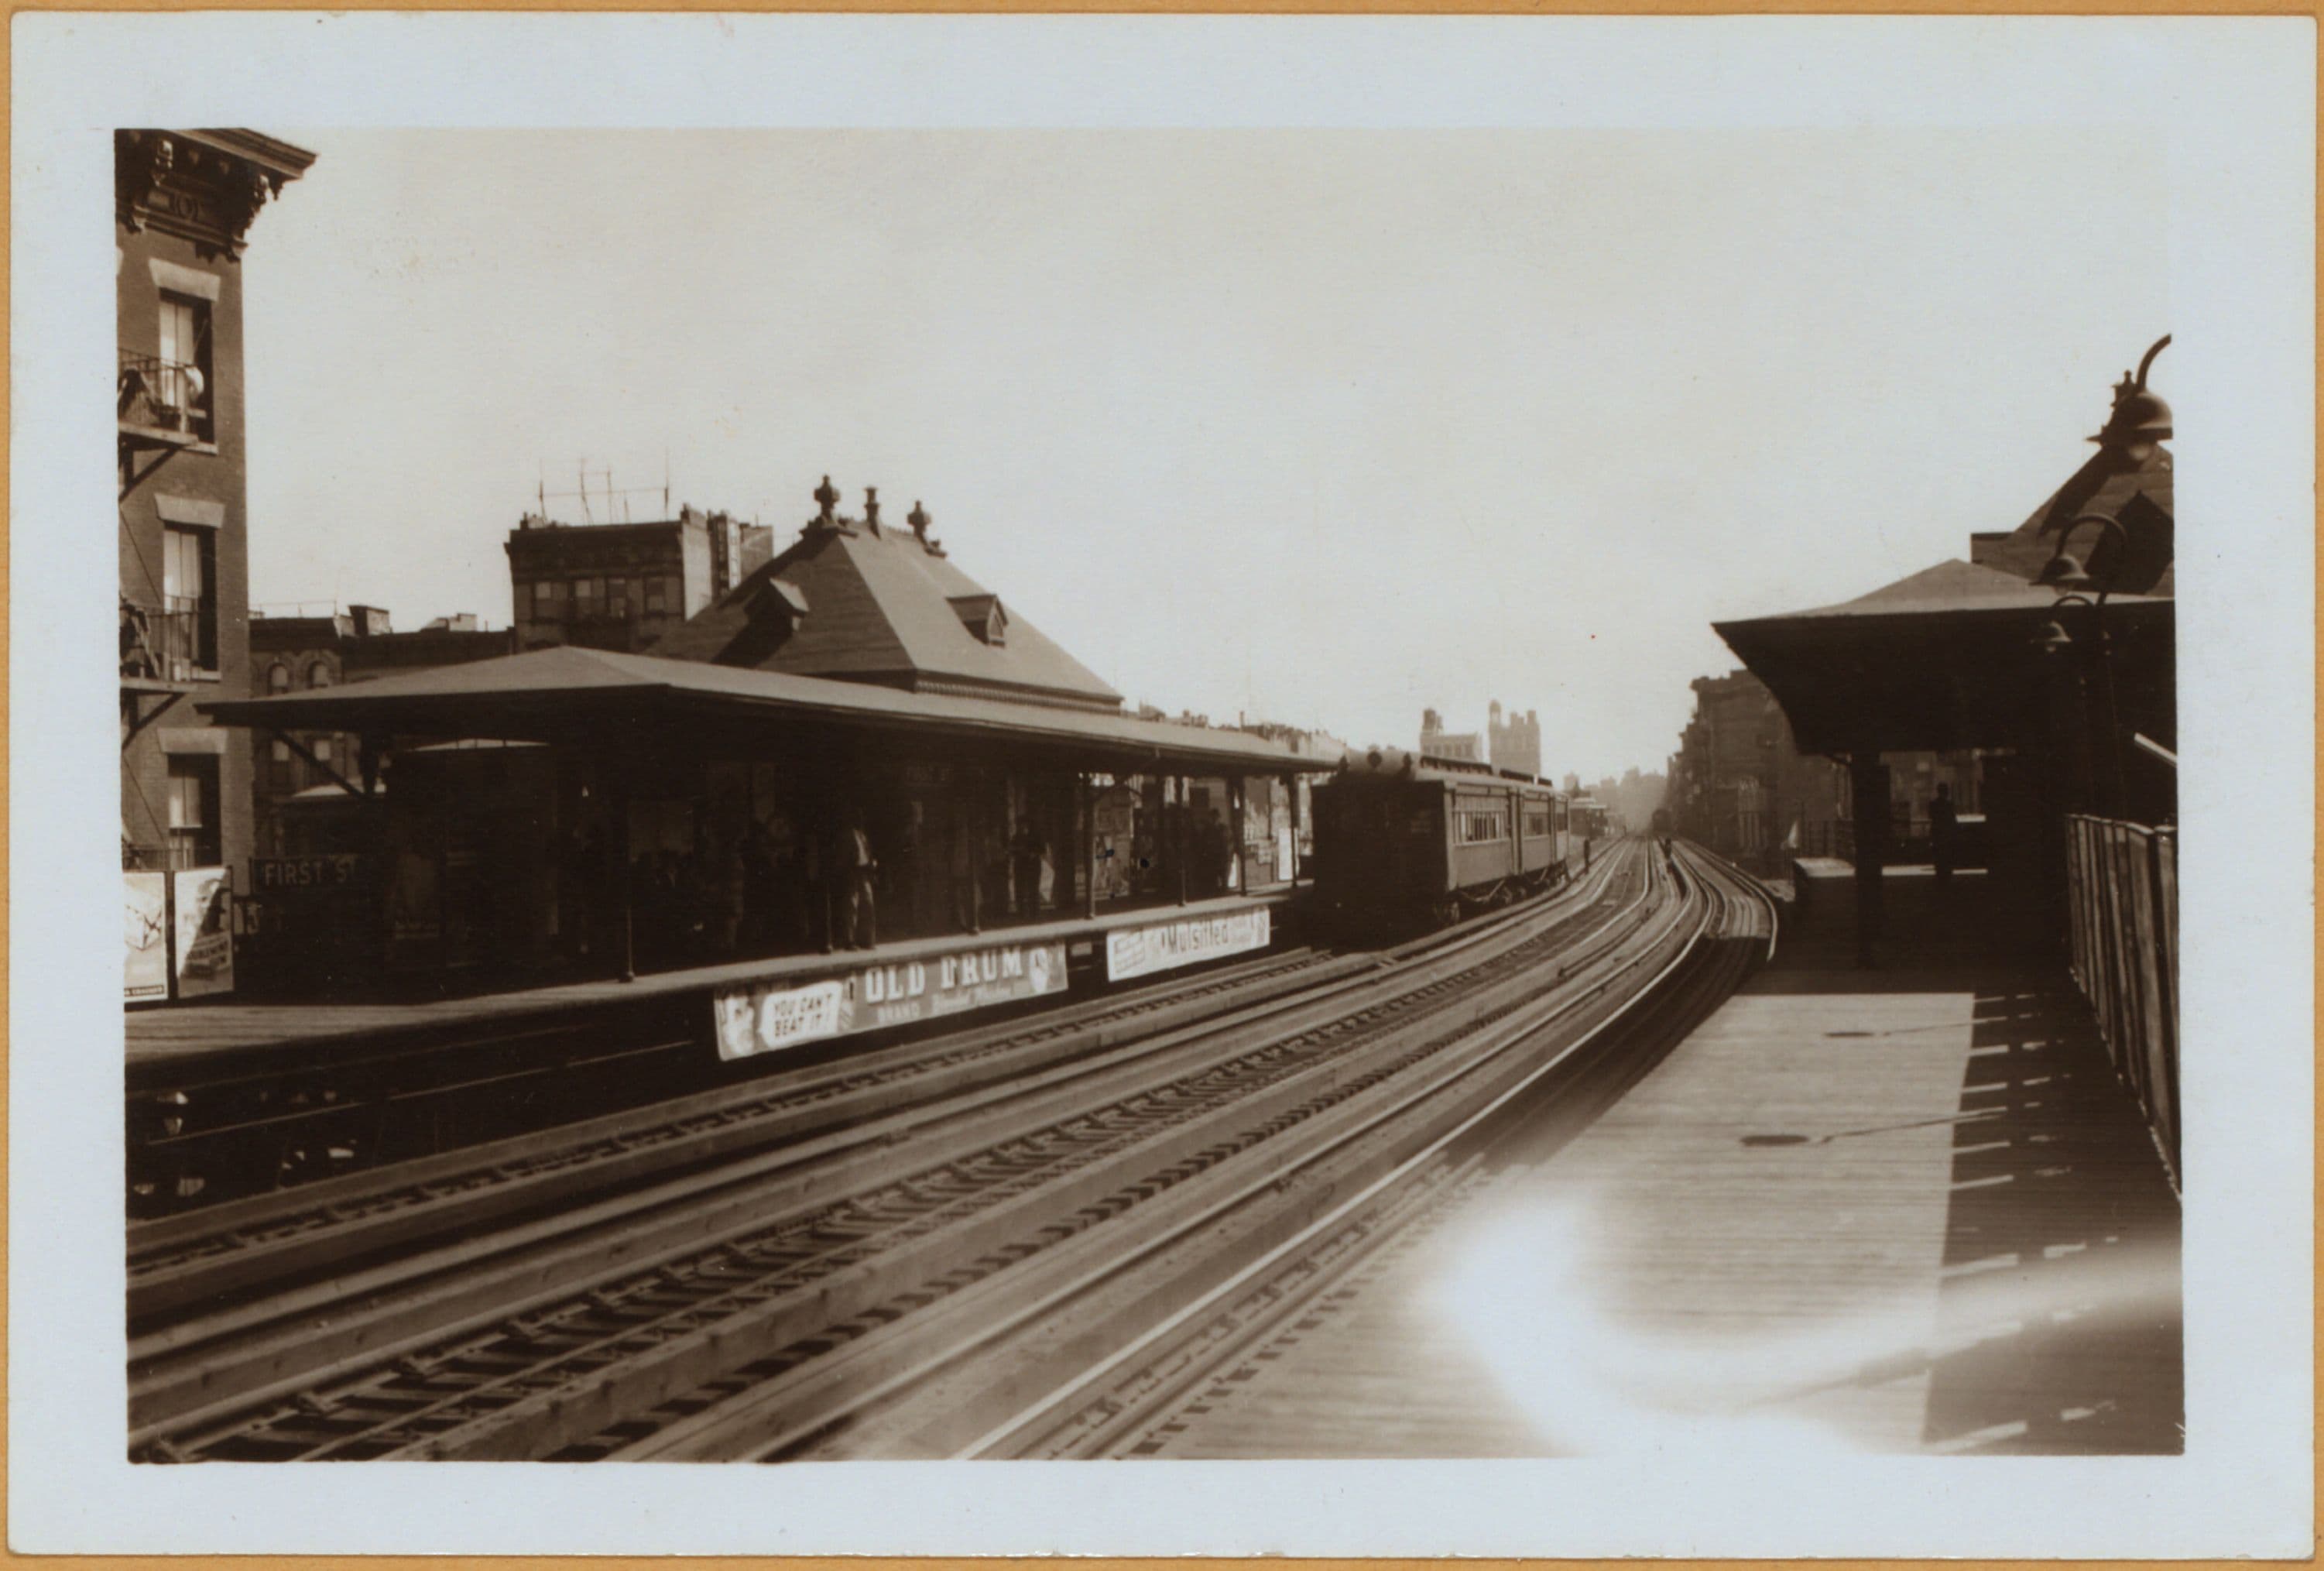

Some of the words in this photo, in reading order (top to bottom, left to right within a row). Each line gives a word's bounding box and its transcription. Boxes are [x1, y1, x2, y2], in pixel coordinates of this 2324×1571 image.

[264, 860, 324, 886] FIRST
[865, 962, 925, 1004] OLD
[940, 946, 1023, 990] DRUM
[774, 999, 796, 1017] YOU
[775, 1015, 804, 1038] BEAT
